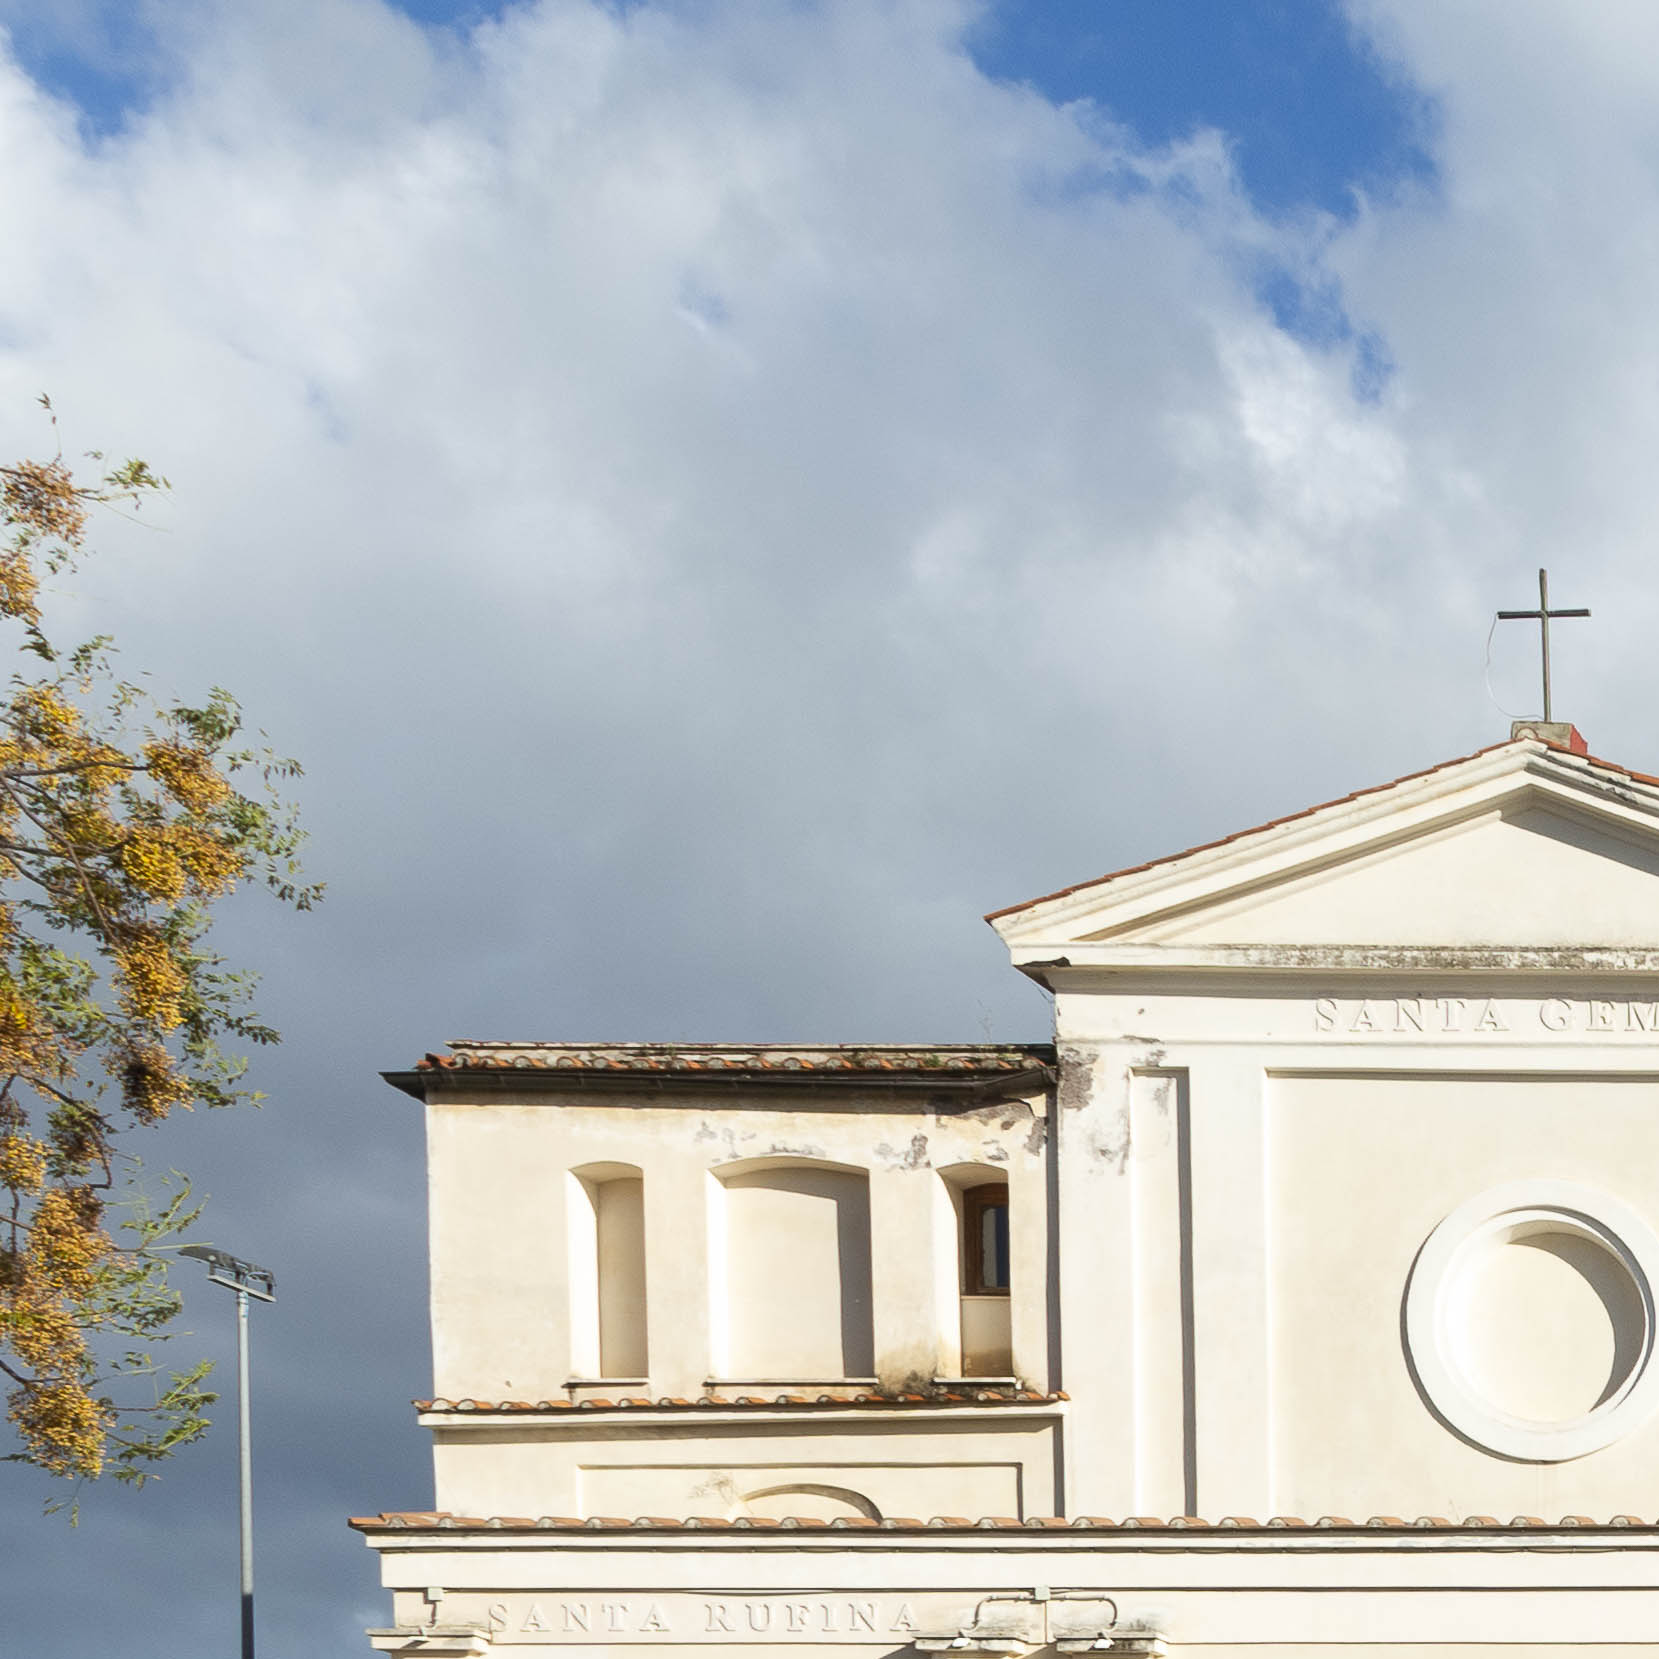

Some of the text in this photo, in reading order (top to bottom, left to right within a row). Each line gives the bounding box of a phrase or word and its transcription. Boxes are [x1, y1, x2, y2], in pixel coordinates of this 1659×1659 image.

[1315, 997, 1510, 1032] SANTA
[488, 1601, 920, 1633] SANTA RUFINA
